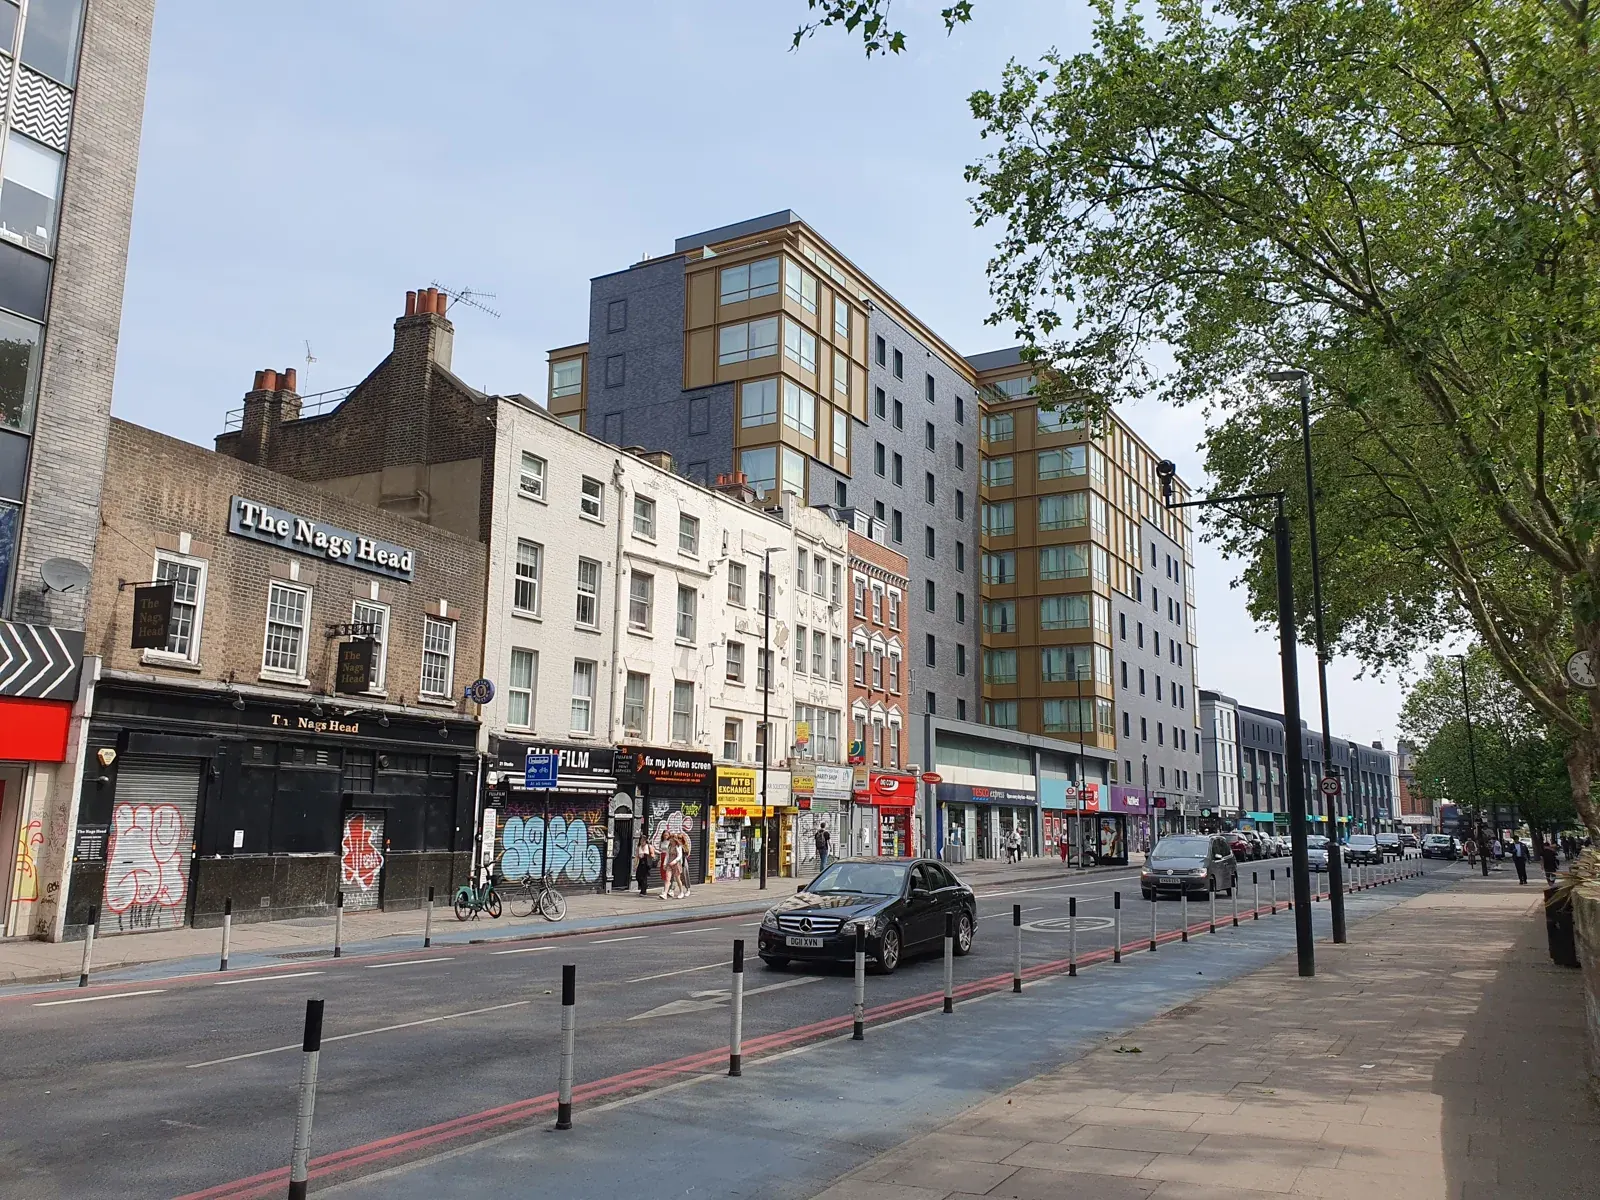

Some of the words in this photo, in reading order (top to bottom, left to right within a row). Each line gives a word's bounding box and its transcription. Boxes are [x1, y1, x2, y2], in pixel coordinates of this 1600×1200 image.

[241, 501, 290, 537] The
[295, 517, 352, 558] Nags
[356, 536, 413, 573] Head
[141, 598, 160, 609] The
[140, 612, 163, 625] Nags
[139, 624, 164, 637] Head
[343, 651, 361, 660] The
[342, 662, 364, 673] Nags
[341, 673, 365, 683] Head
[298, 717, 328, 733] Nags
[329, 720, 359, 733] Head
[645, 755, 654, 766] fix
[655, 759, 666, 769] my
[667, 758, 690, 769] broken
[691, 761, 712, 770] screen
[731, 777, 751, 786] MTB
[718, 785, 751, 794] EXCHANGE
[971, 787, 989, 797] TESCO
[989, 790, 1005, 800] express
[804, 938, 818, 947] XVN
